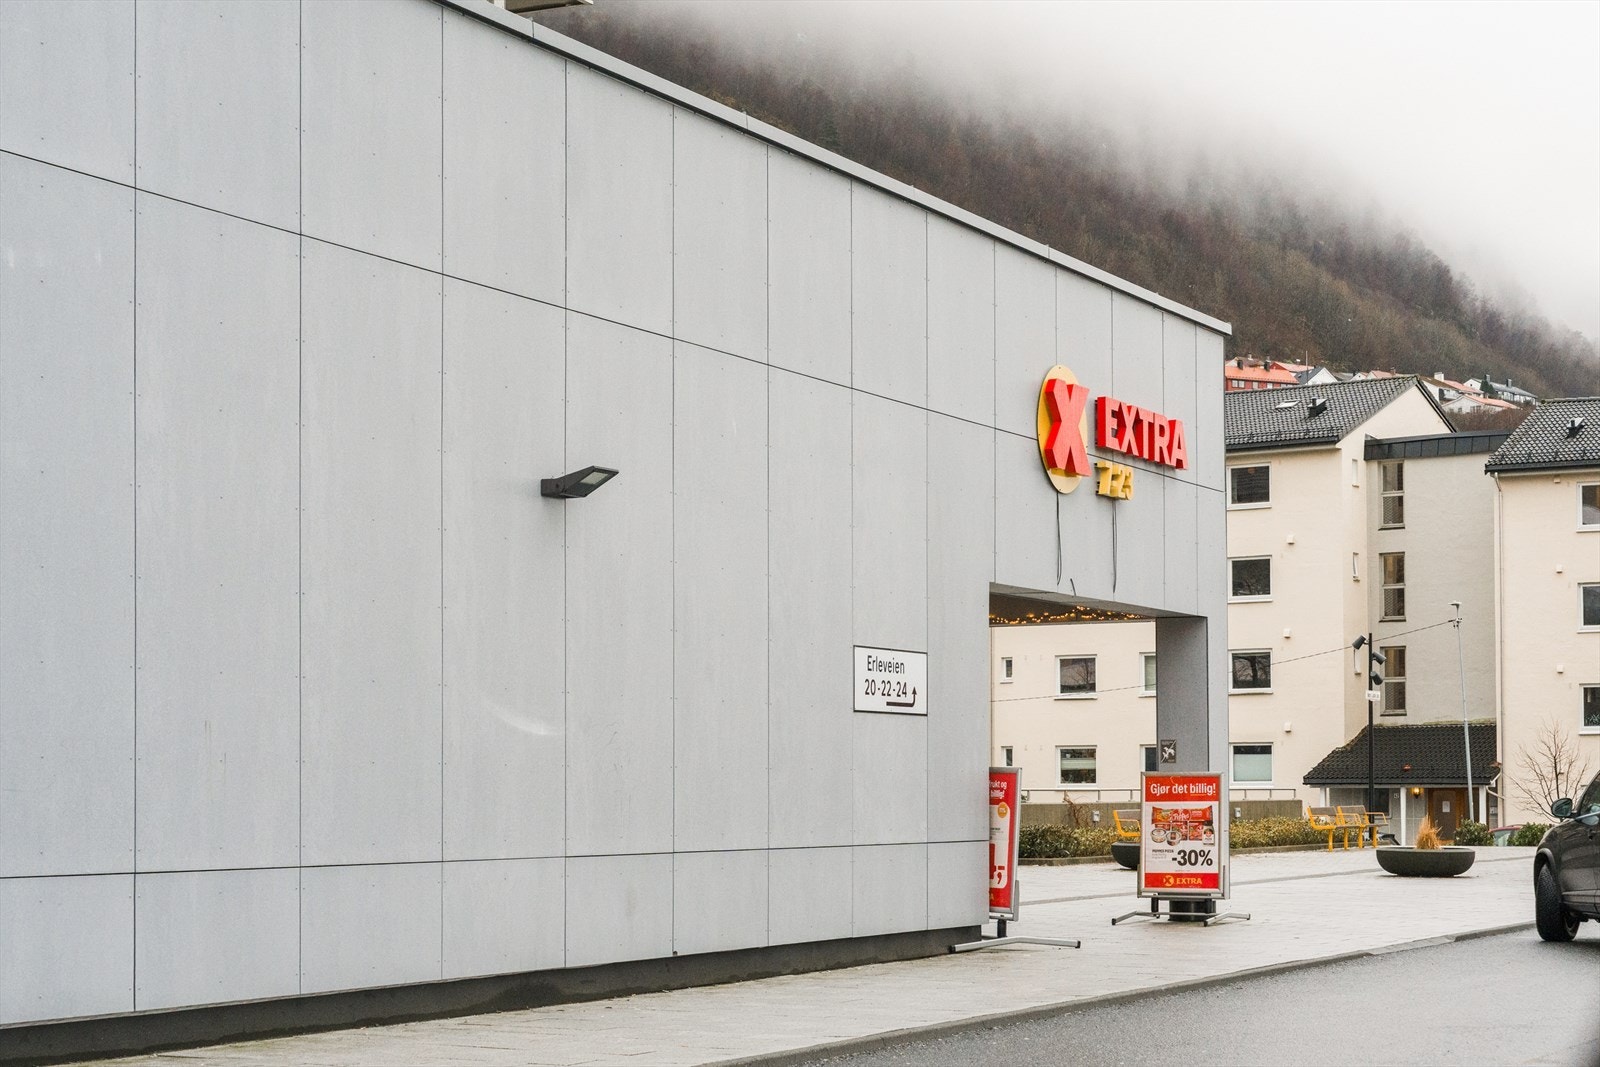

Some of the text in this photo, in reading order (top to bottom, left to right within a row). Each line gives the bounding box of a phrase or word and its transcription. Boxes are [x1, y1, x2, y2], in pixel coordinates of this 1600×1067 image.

[1096, 396, 1188, 470] EXTRA
[1095, 460, 1134, 500] 7-23
[867, 655, 905, 674] Erleveien
[864, 678, 908, 698] 20-22-24
[1150, 782, 1216, 796] Gjør det billig!
[1171, 849, 1213, 866] -30%
[1176, 877, 1202, 885] EXTRA
